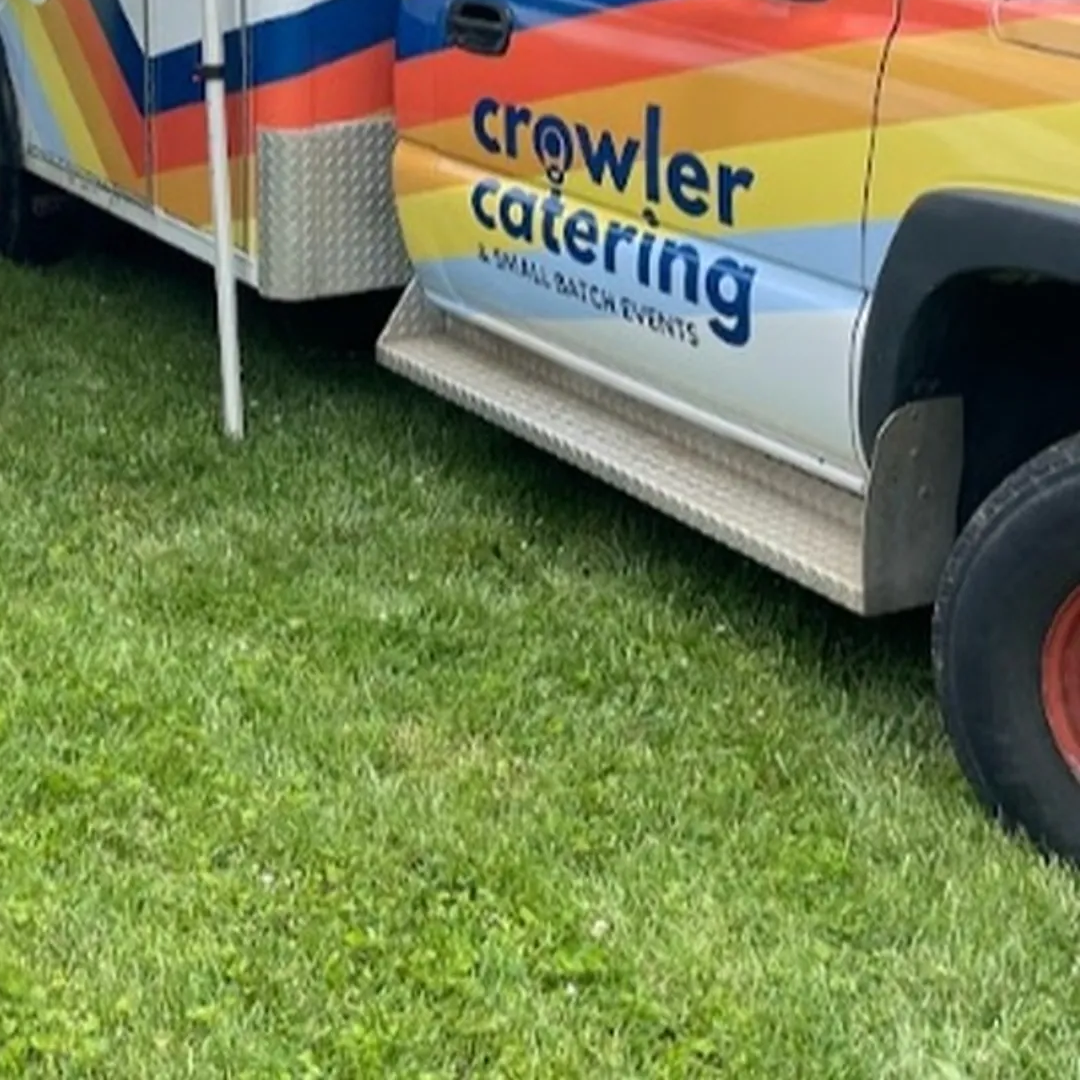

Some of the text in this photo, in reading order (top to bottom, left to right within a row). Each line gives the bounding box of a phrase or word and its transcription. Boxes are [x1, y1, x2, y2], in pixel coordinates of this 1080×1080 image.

[472, 96, 754, 226] crowler
[470, 178, 757, 347] catering
[493, 247, 551, 290] SMALL
[554, 271, 617, 314] BATCH
[621, 296, 699, 348] EVENTS
